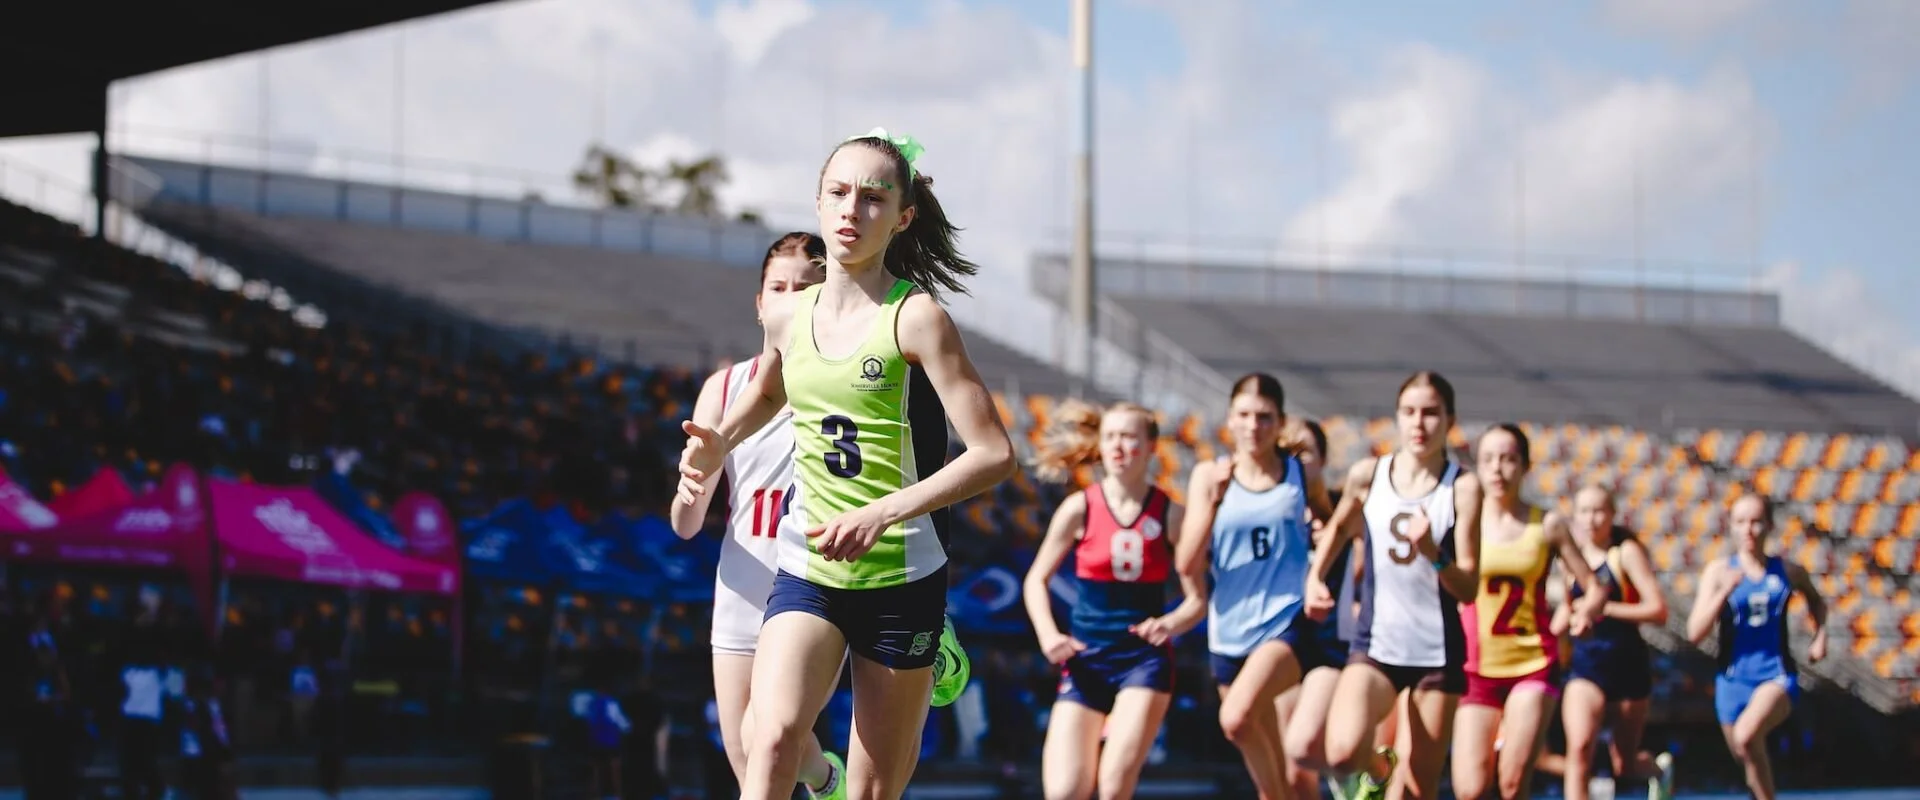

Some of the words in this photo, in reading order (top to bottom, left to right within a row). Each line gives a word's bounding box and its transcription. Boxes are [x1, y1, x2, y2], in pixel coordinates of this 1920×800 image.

[821, 414, 862, 479] 3
[752, 488, 783, 538] 11
[1110, 529, 1144, 582] 8
[1251, 526, 1270, 561] 6
[1487, 575, 1528, 636] 2
